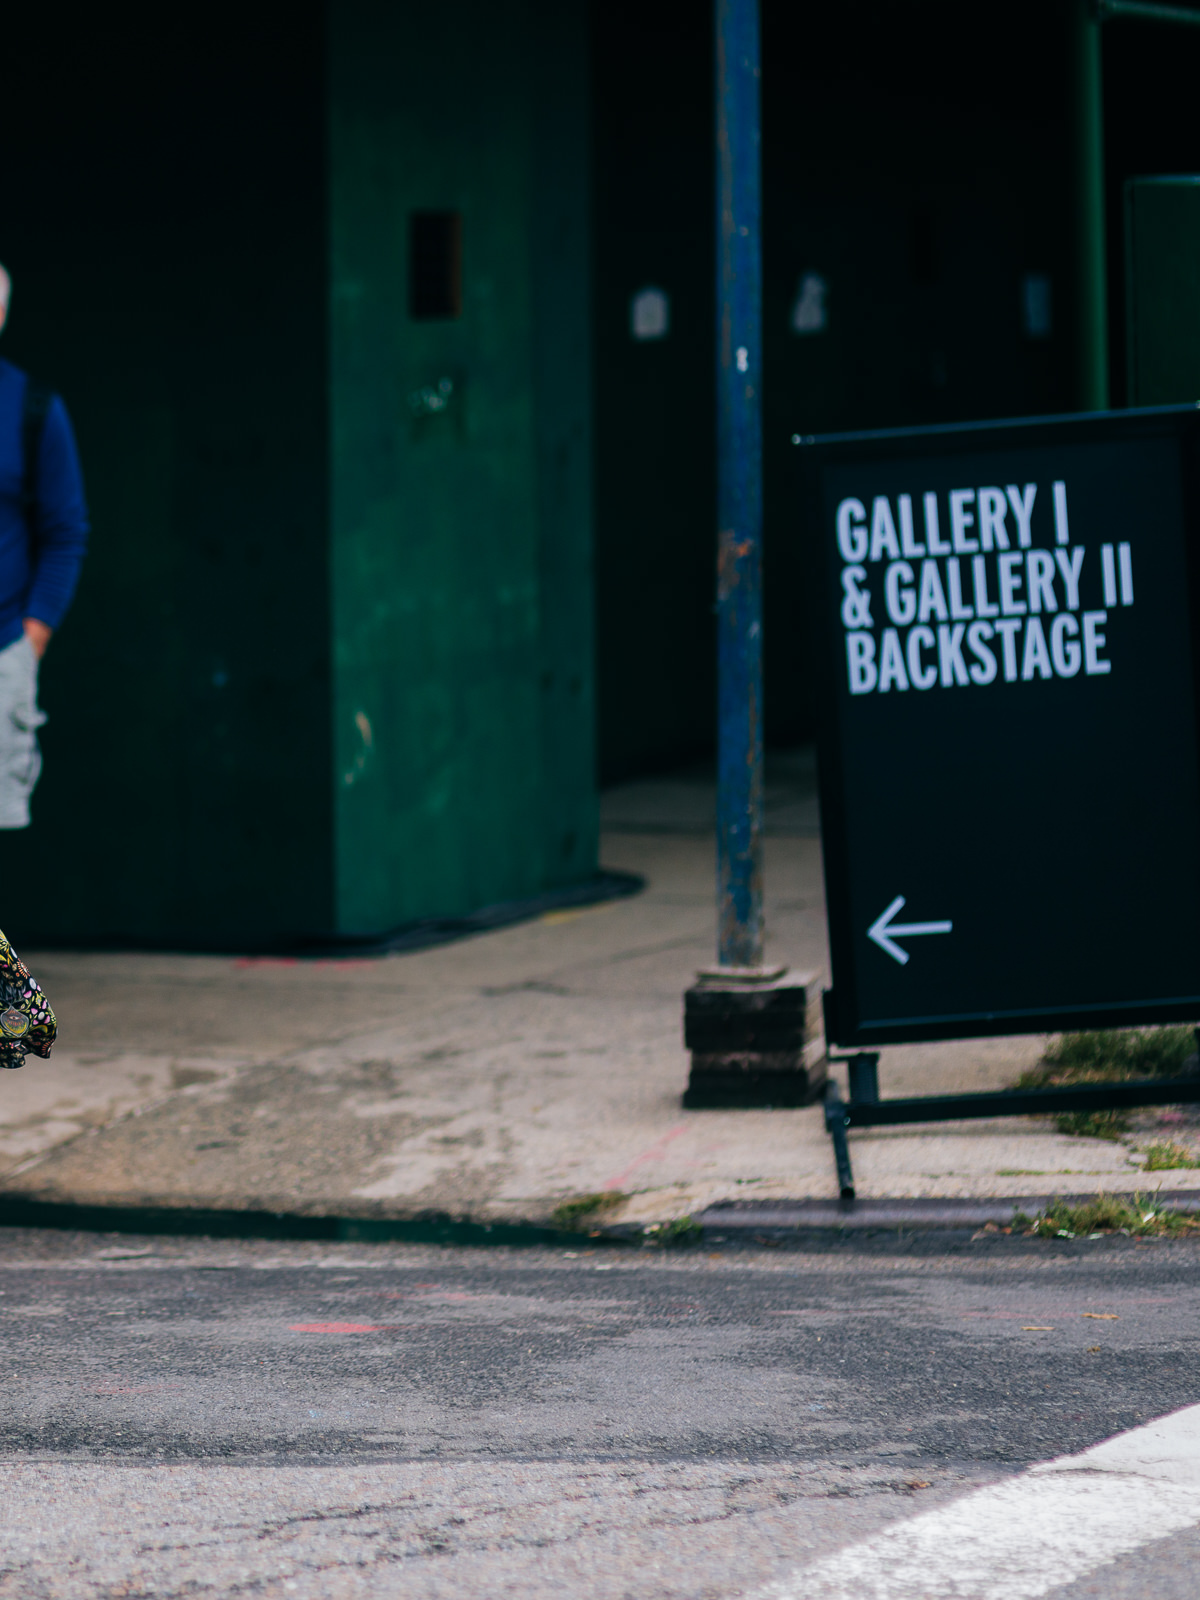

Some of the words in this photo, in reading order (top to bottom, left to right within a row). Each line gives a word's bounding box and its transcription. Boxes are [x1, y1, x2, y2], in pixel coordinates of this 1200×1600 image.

[836, 482, 1038, 564] GALLERY
[1052, 480, 1070, 546] I
[841, 564, 874, 630] &
[884, 546, 1085, 626] GALLERY
[1101, 542, 1134, 608] II
[846, 610, 1112, 695] BACKSTAGE
